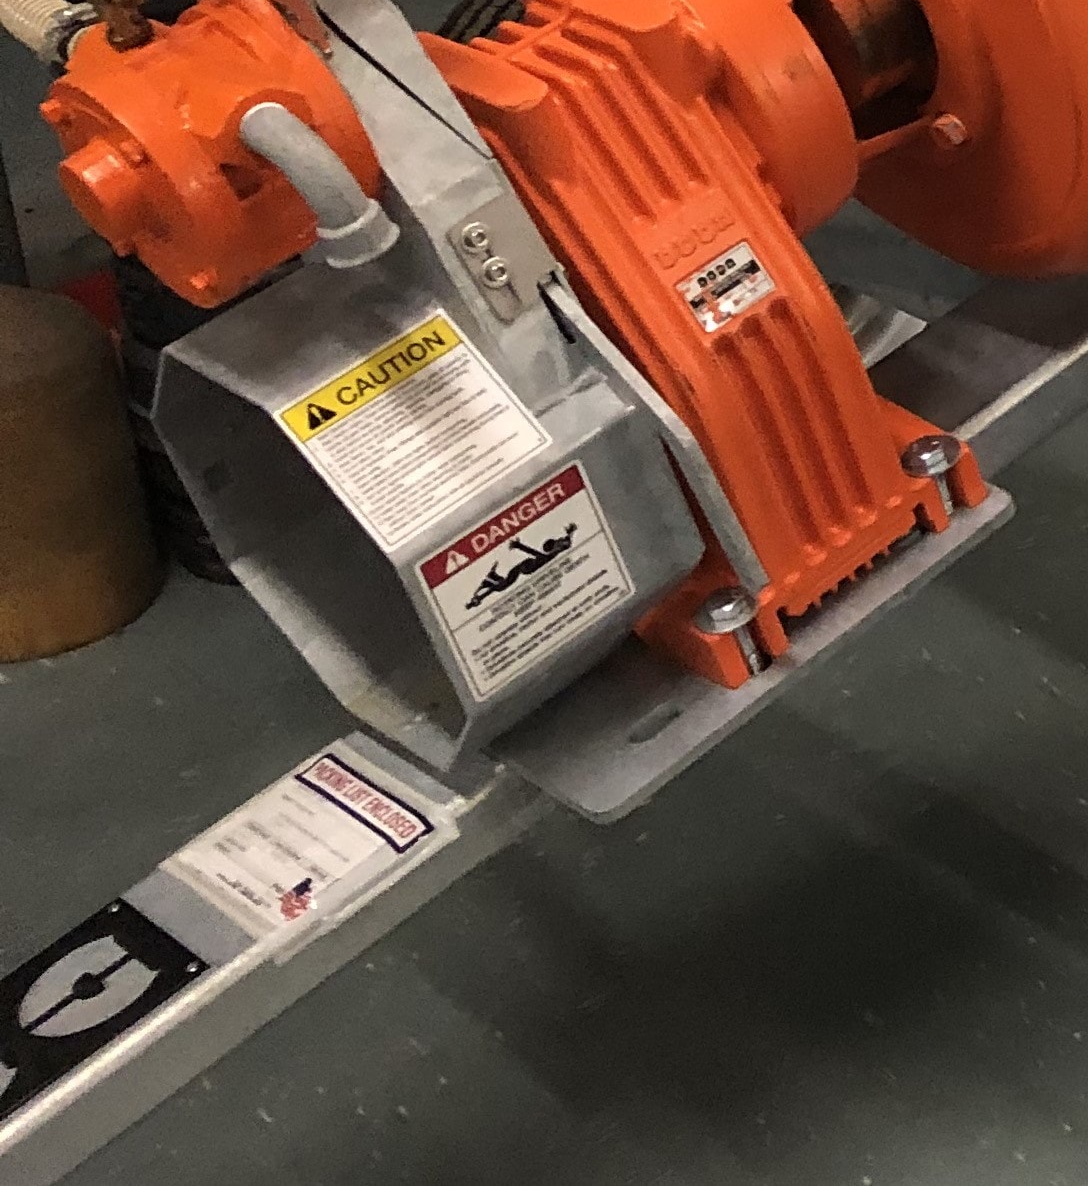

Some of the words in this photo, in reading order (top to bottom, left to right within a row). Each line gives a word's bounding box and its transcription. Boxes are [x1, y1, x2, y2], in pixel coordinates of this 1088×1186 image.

[697, 257, 737, 289] DODA
[336, 330, 446, 406] CAUTION
[470, 482, 567, 554] DANGER
[313, 762, 353, 797] PACKING
[342, 780, 371, 808] LIST
[361, 794, 419, 840] ENCLOSED
